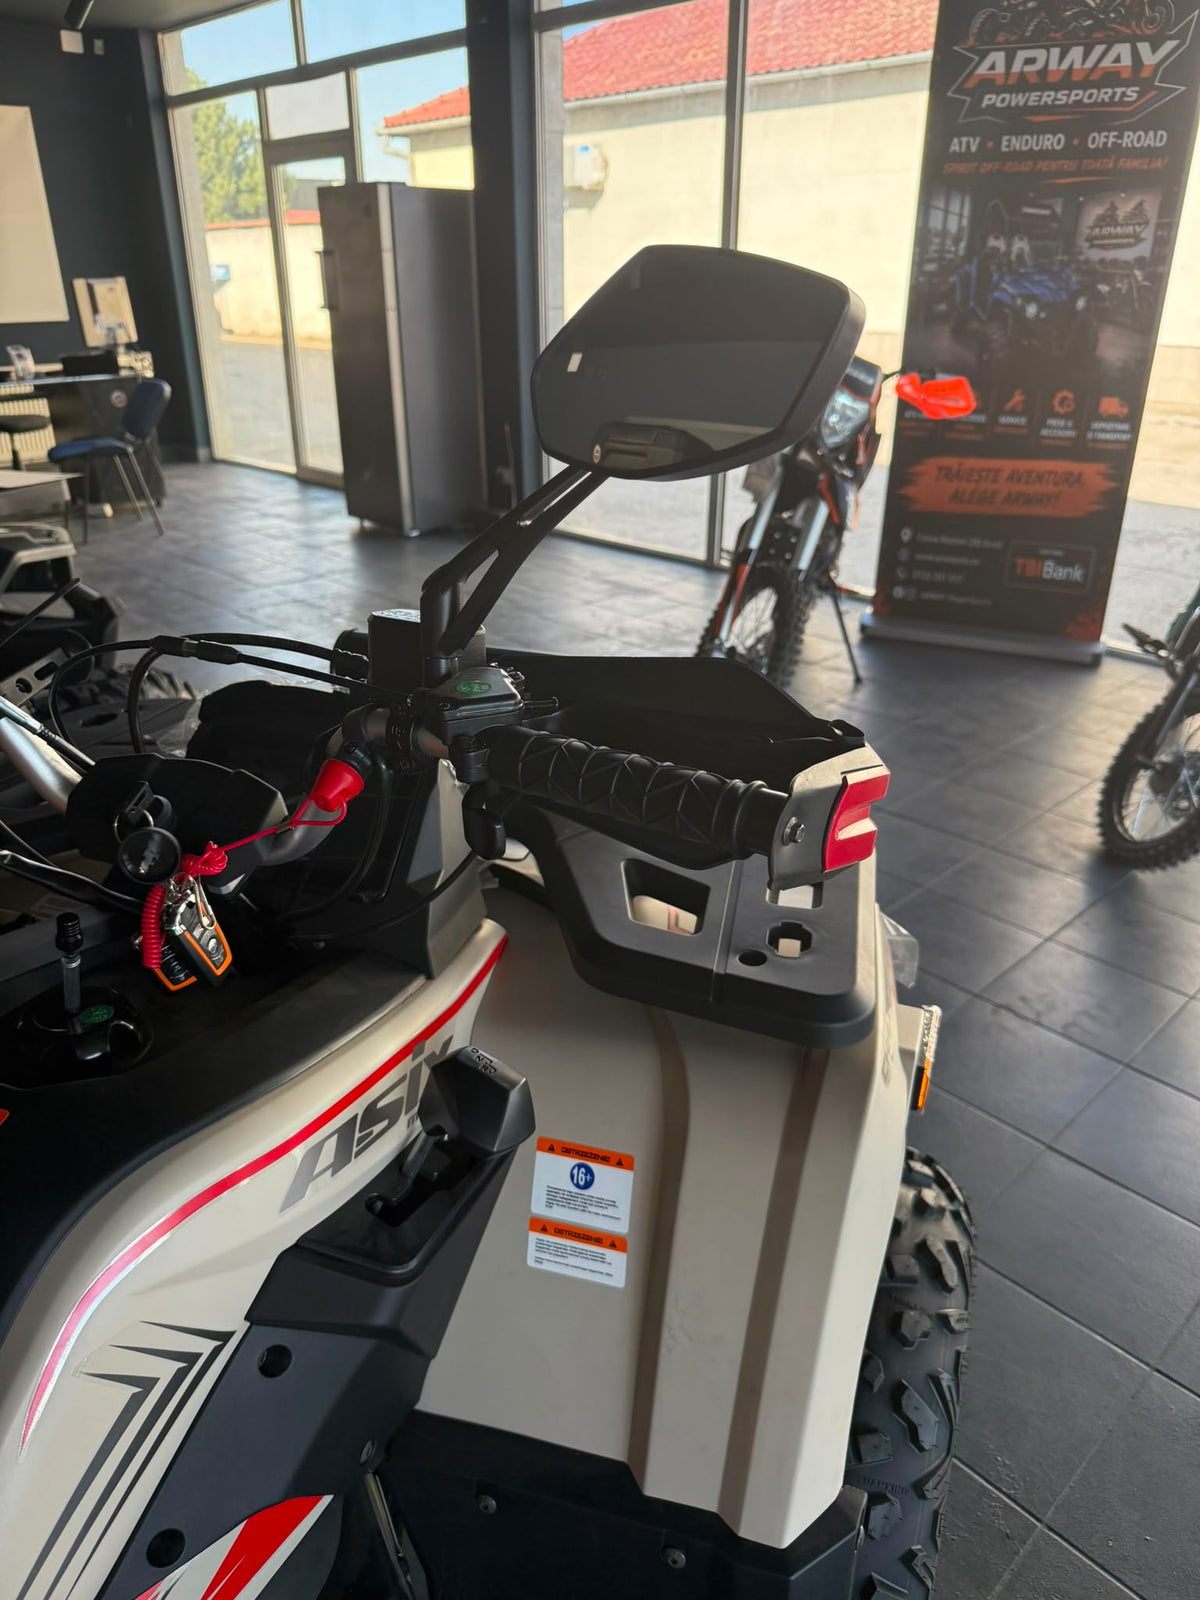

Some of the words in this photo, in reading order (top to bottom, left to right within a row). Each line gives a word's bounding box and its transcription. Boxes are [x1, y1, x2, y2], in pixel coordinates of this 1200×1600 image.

[963, 40, 1180, 89] ARWAY
[981, 87, 1140, 109] POWERSPORTS
[949, 136, 980, 153] ATV
[1001, 134, 1065, 152] ENDURO
[1087, 130, 1168, 149] OFF-ROAD
[572, 1166, 592, 1186] 16+
